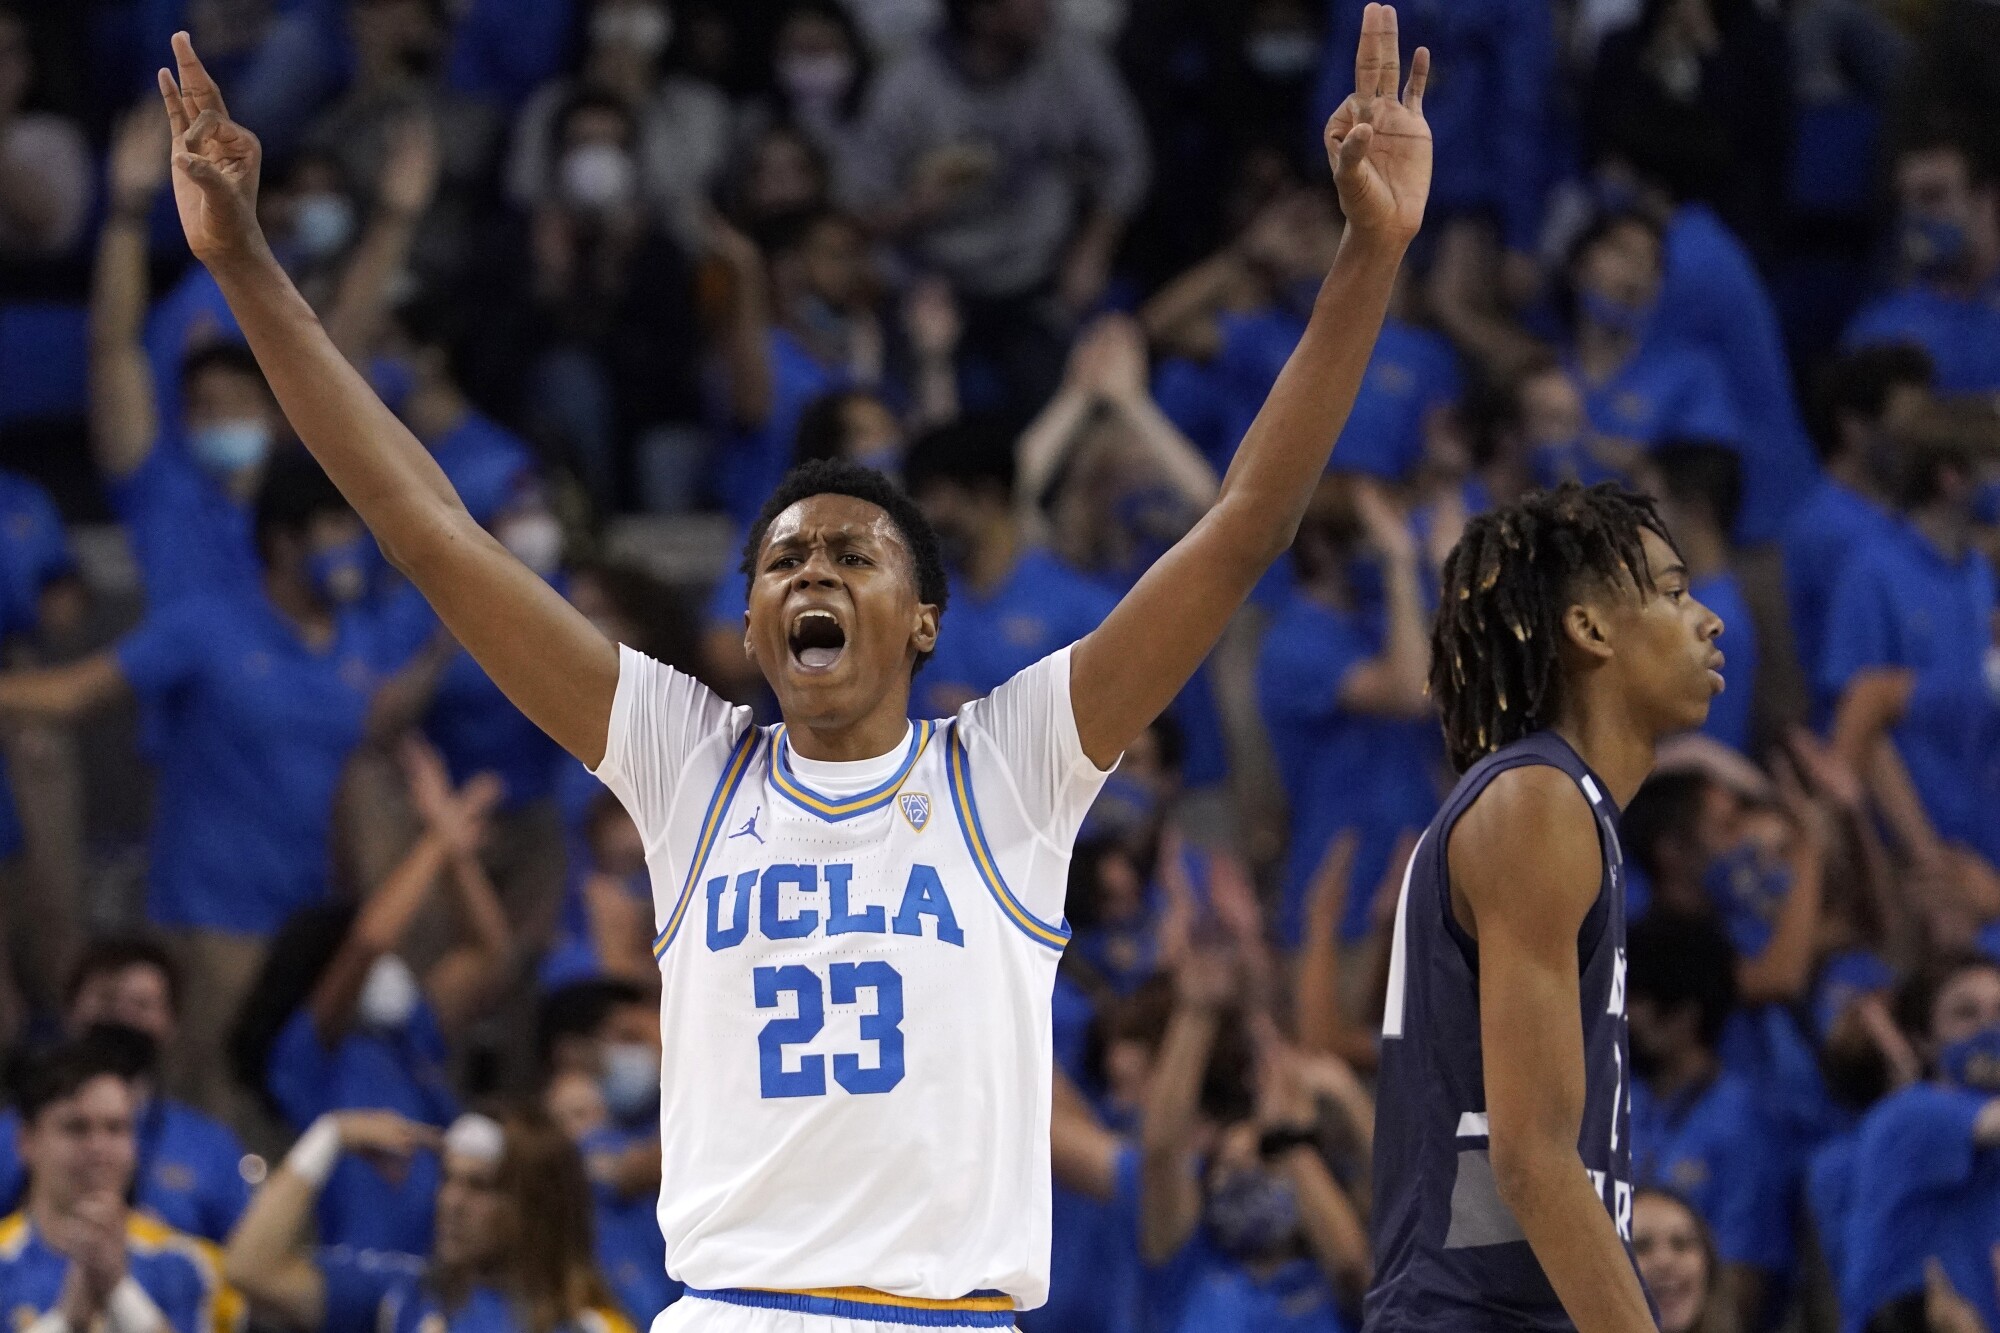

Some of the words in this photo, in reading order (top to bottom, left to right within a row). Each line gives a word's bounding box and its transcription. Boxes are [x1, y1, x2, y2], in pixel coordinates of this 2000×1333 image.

[900, 795, 928, 815] PAC
[909, 809, 925, 822] 12
[706, 863, 964, 952] UCLA
[753, 960, 905, 1099] 23
